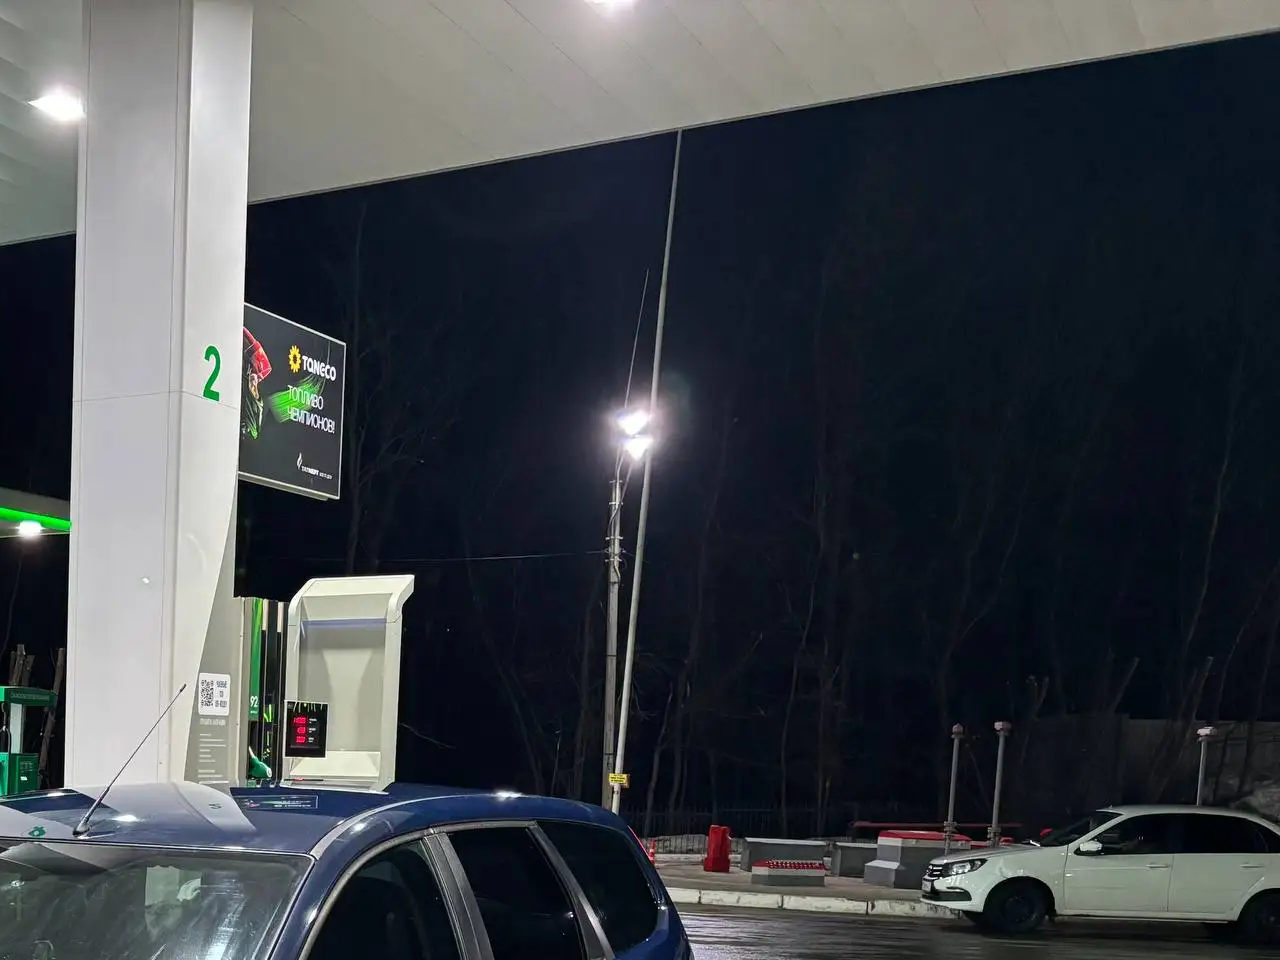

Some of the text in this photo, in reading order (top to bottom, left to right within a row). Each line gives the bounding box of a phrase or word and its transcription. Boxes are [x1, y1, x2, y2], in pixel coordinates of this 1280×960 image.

[202, 344, 222, 402] 2
[287, 384, 324, 410] ТОПЛИВО
[287, 405, 336, 434] ЧЕМПИОНОВ!
[250, 695, 259, 708] 92
